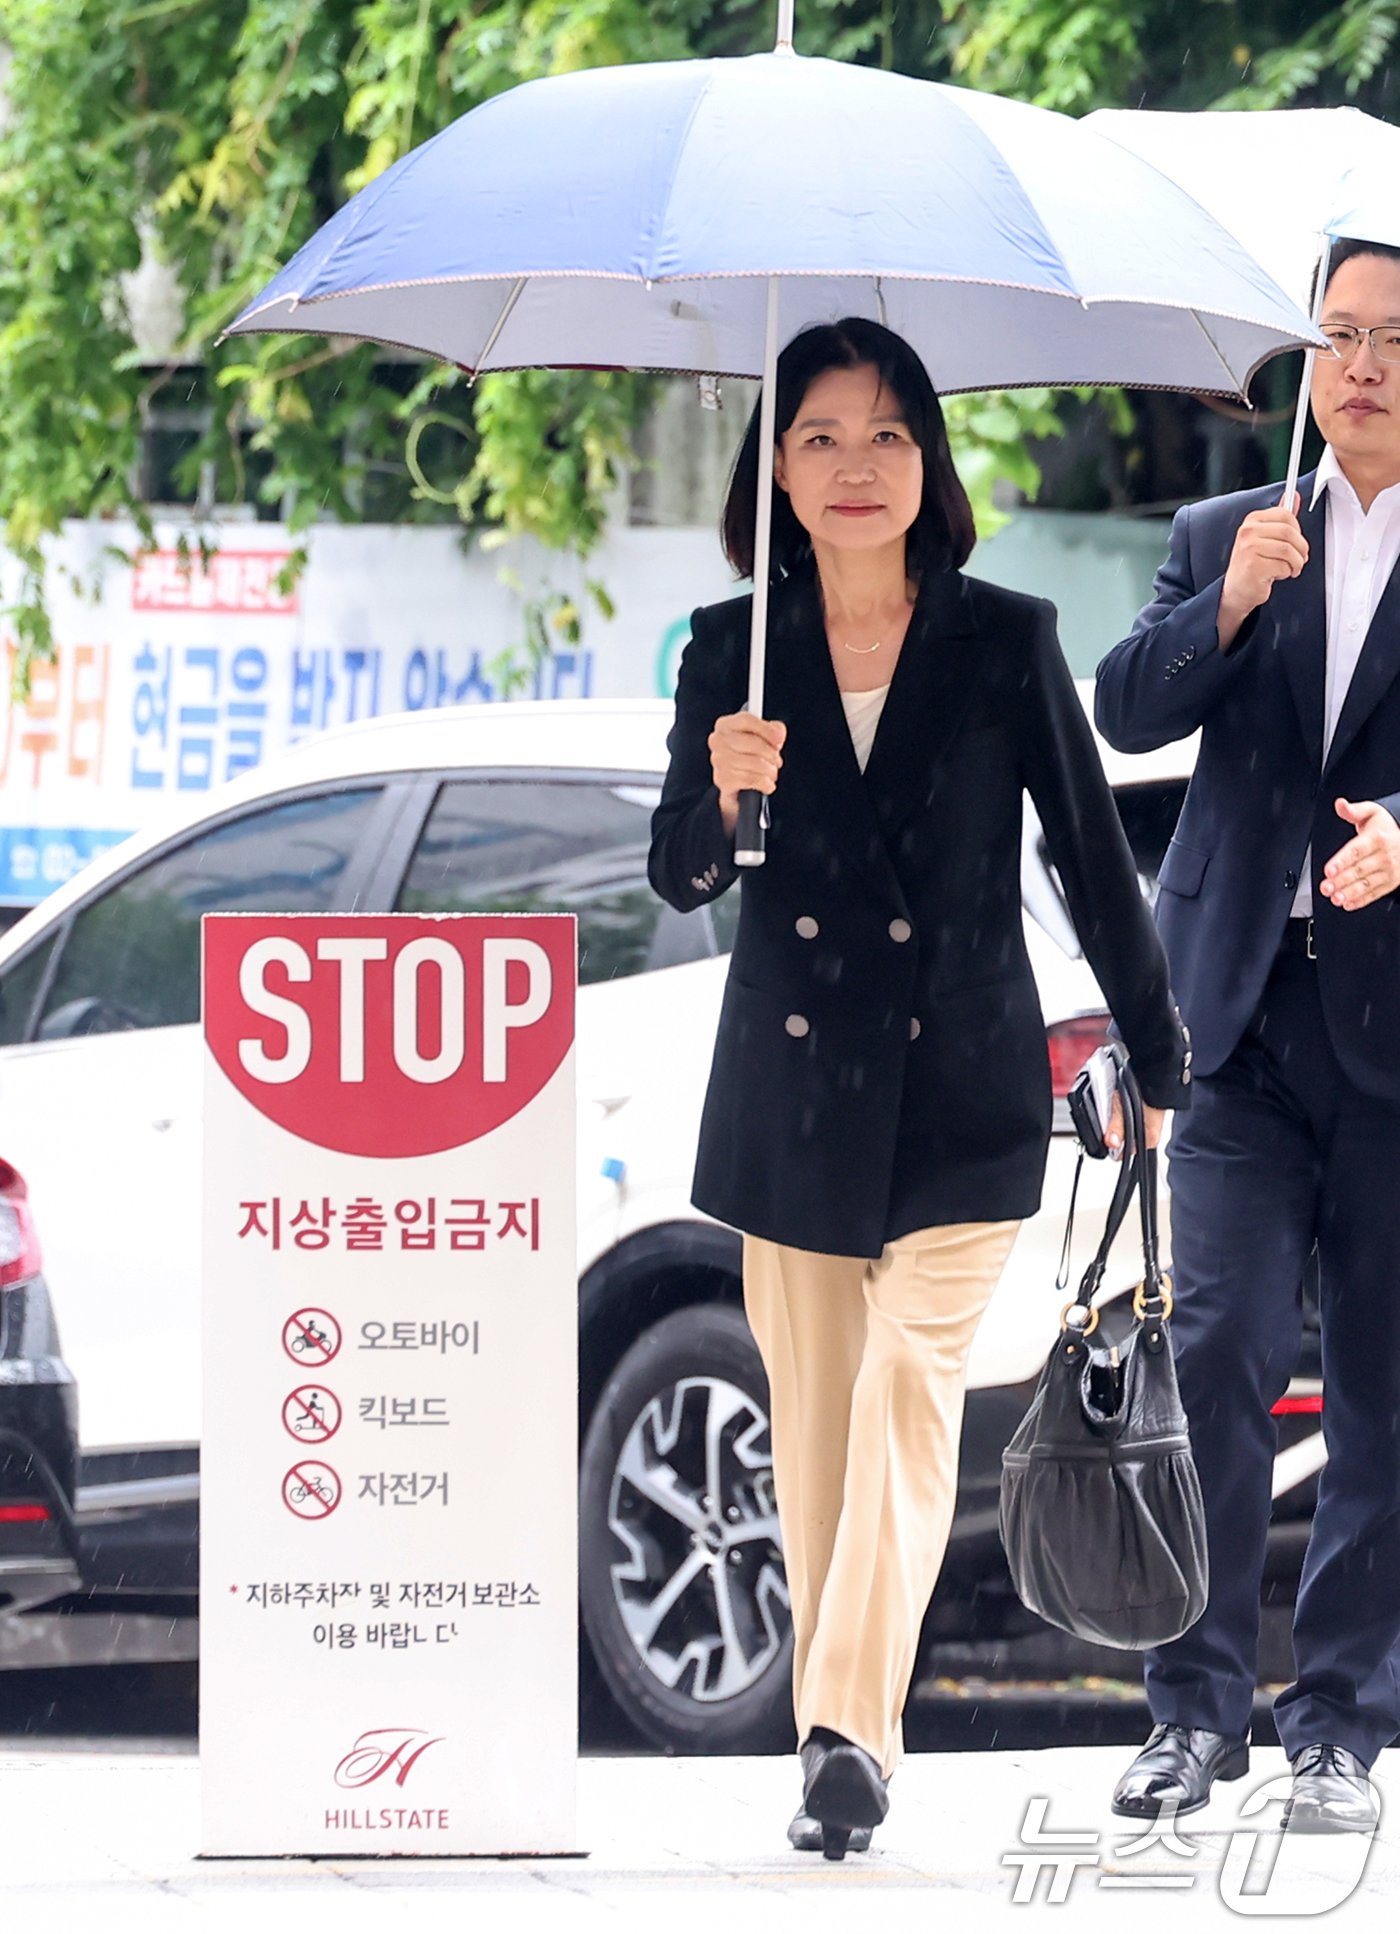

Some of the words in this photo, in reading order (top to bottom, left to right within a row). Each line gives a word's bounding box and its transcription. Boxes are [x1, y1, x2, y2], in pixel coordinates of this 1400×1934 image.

[0, 638, 109, 789] 부터
[130, 640, 268, 790] 현금을
[238, 936, 552, 1084] STOP
[238, 1197, 540, 1251] 지상출입금지
[357, 1320, 480, 1355] 오토바이
[358, 1396, 450, 1429] 킥보드
[357, 1472, 449, 1506] 자전거
[369, 1581, 390, 1609] 및
[398, 1581, 467, 1608] 자전거
[471, 1581, 541, 1608] 보관소
[313, 1622, 358, 1650] 이용
[324, 1808, 450, 1829] HILLSTATE
